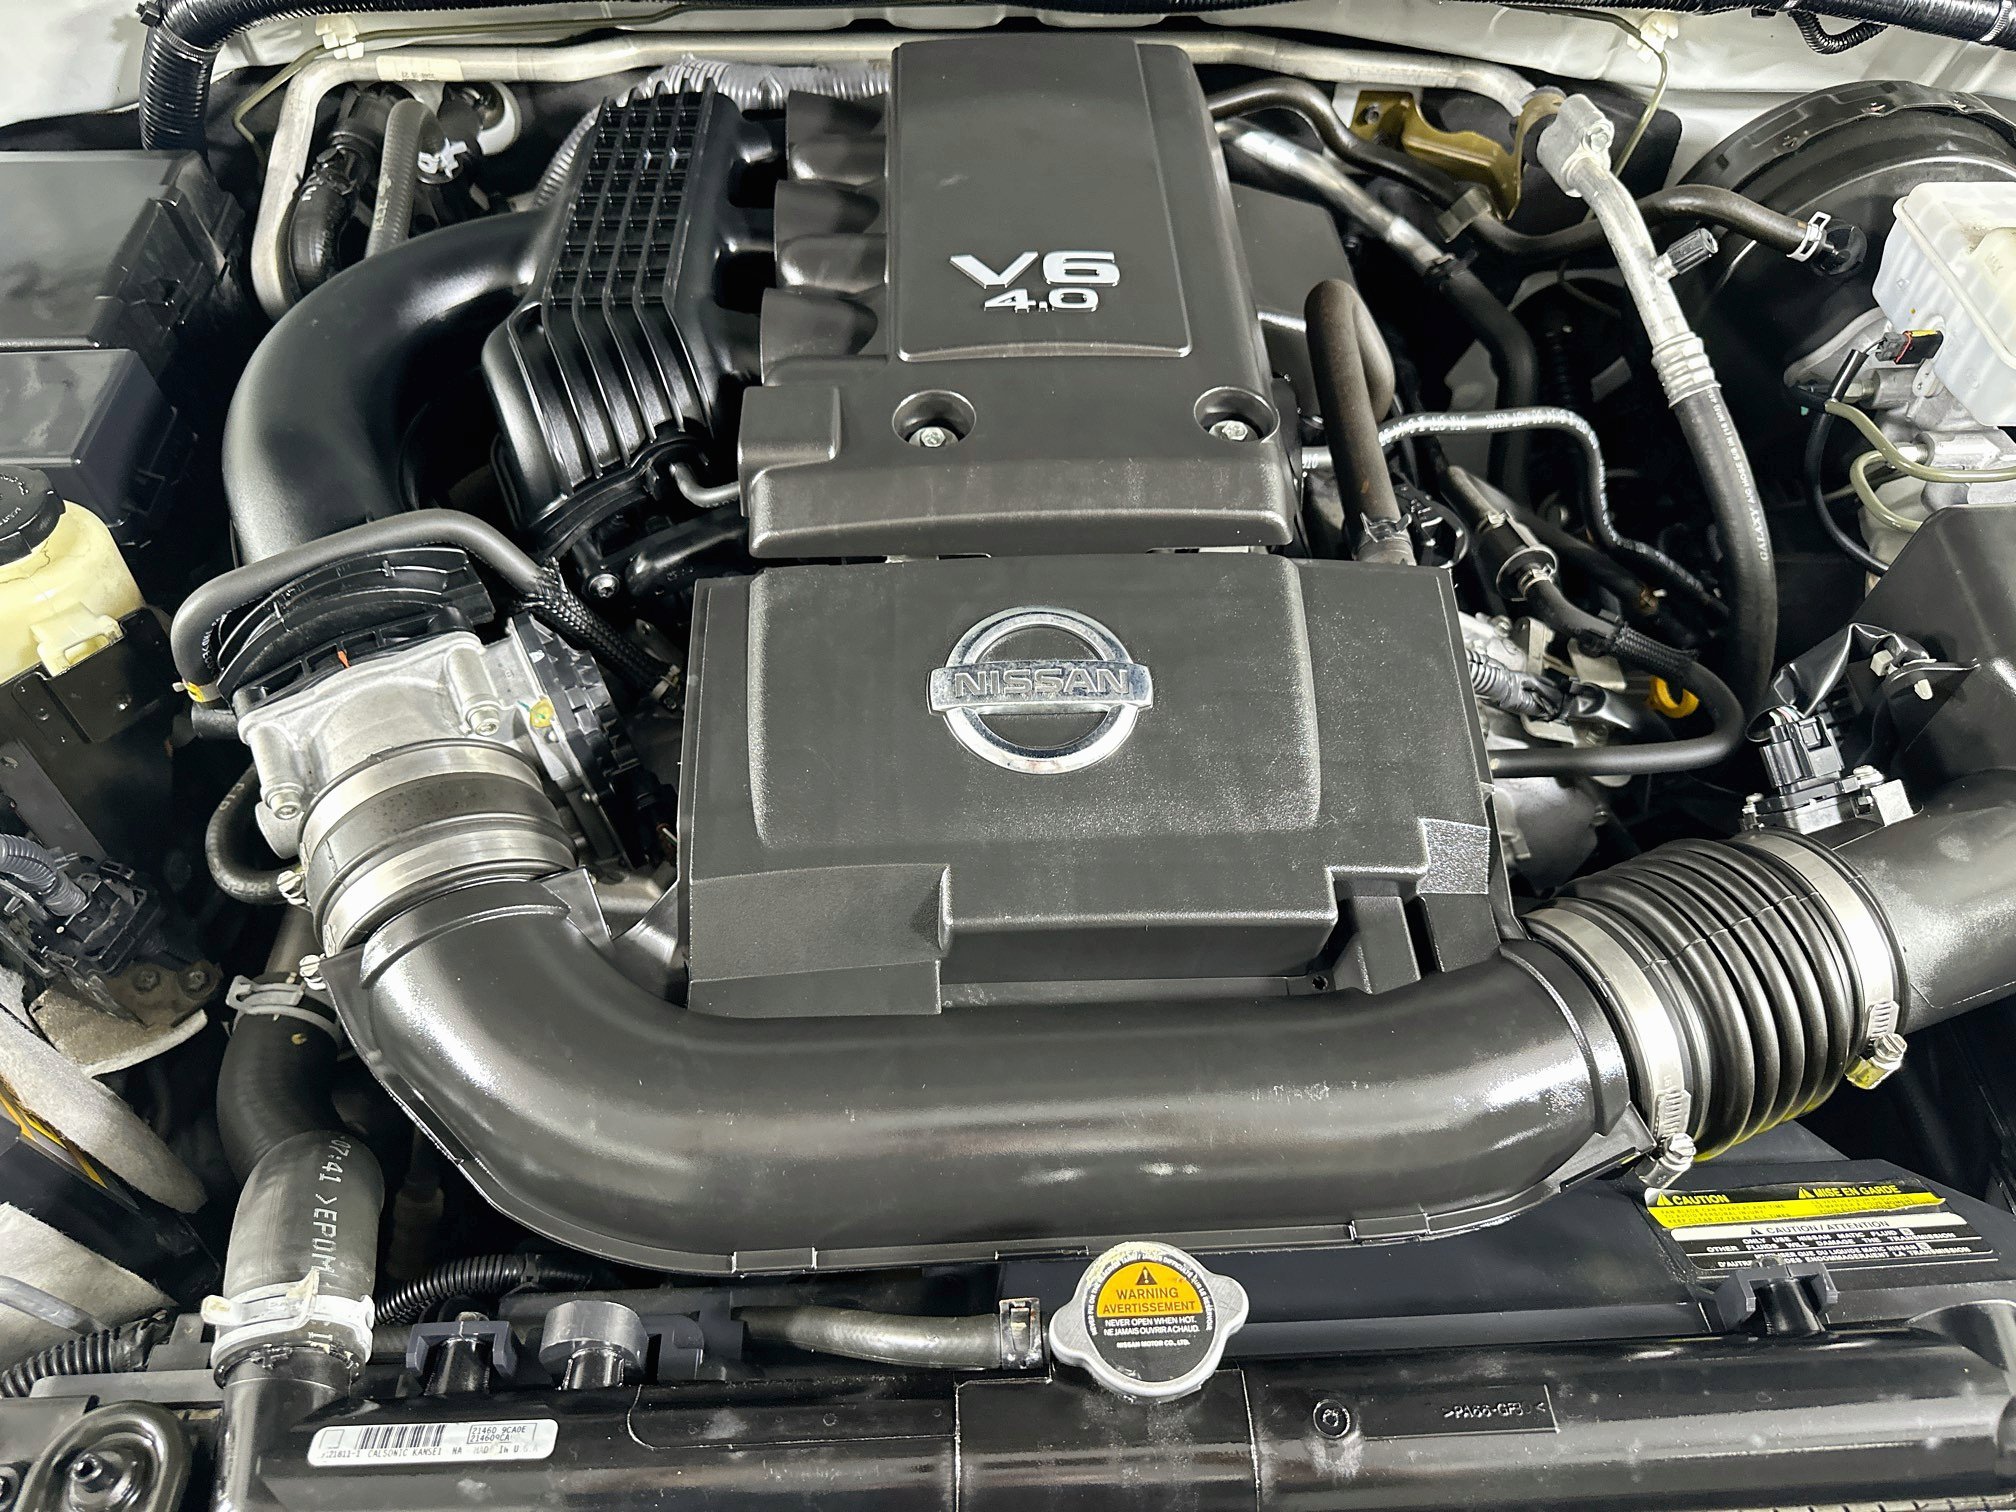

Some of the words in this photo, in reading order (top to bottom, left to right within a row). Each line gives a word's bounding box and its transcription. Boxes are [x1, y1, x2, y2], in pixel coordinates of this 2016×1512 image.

[949, 251, 1121, 289] V6
[984, 287, 1099, 313] 4.0
[1735, 461, 1750, 488] HOSE
[1749, 506, 1770, 562] GALAXY
[954, 667, 1130, 698] NISSAN
[317, 1135, 353, 1183] 07:41
[1813, 1187, 1840, 1198] MISE
[1841, 1186, 1860, 1196] EN
[1860, 1185, 1902, 1195] GARDE
[1673, 1194, 1731, 1206] CAUTION
[1767, 1223, 1818, 1235] CAUTION
[1827, 1220, 1890, 1231] ATTENTION
[1706, 1245, 1739, 1253] OTHER
[1746, 1243, 1779, 1251] FLUIDS
[1785, 1241, 1810, 1249] WILL
[1815, 1238, 1856, 1247] DAMAGE
[1887, 1232, 1957, 1243] TRANSMISSION
[1742, 1237, 1766, 1245] ONLY
[1771, 1236, 1792, 1244] USE
[1796, 1234, 1832, 1242] NISSAN
[1836, 1232, 1866, 1240] MATIC
[1869, 1230, 1898, 1238] FLUID
[1806, 1251, 1890, 1263] ENDOMMAGERAIENT
[1907, 1246, 1972, 1257] TRANSMISSION
[1830, 1247, 1862, 1255] LIQUIDE
[1860, 1246, 1887, 1254] MATIC
[1886, 1244, 1919, 1252] NISSAN
[1116, 1288, 1178, 1299] WARNING
[1103, 1301, 1196, 1314] AVERTISSEMENT
[1105, 1319, 1130, 1327] NEVER
[1131, 1318, 1153, 1326] OPEN
[1154, 1317, 1178, 1325] WHEN
[1173, 1325, 1200, 1333] CHAUD.
[472, 1426, 498, 1435] 21460
[367, 1448, 409, 1458] CALSONIC
[412, 1447, 442, 1457] KANSEI
